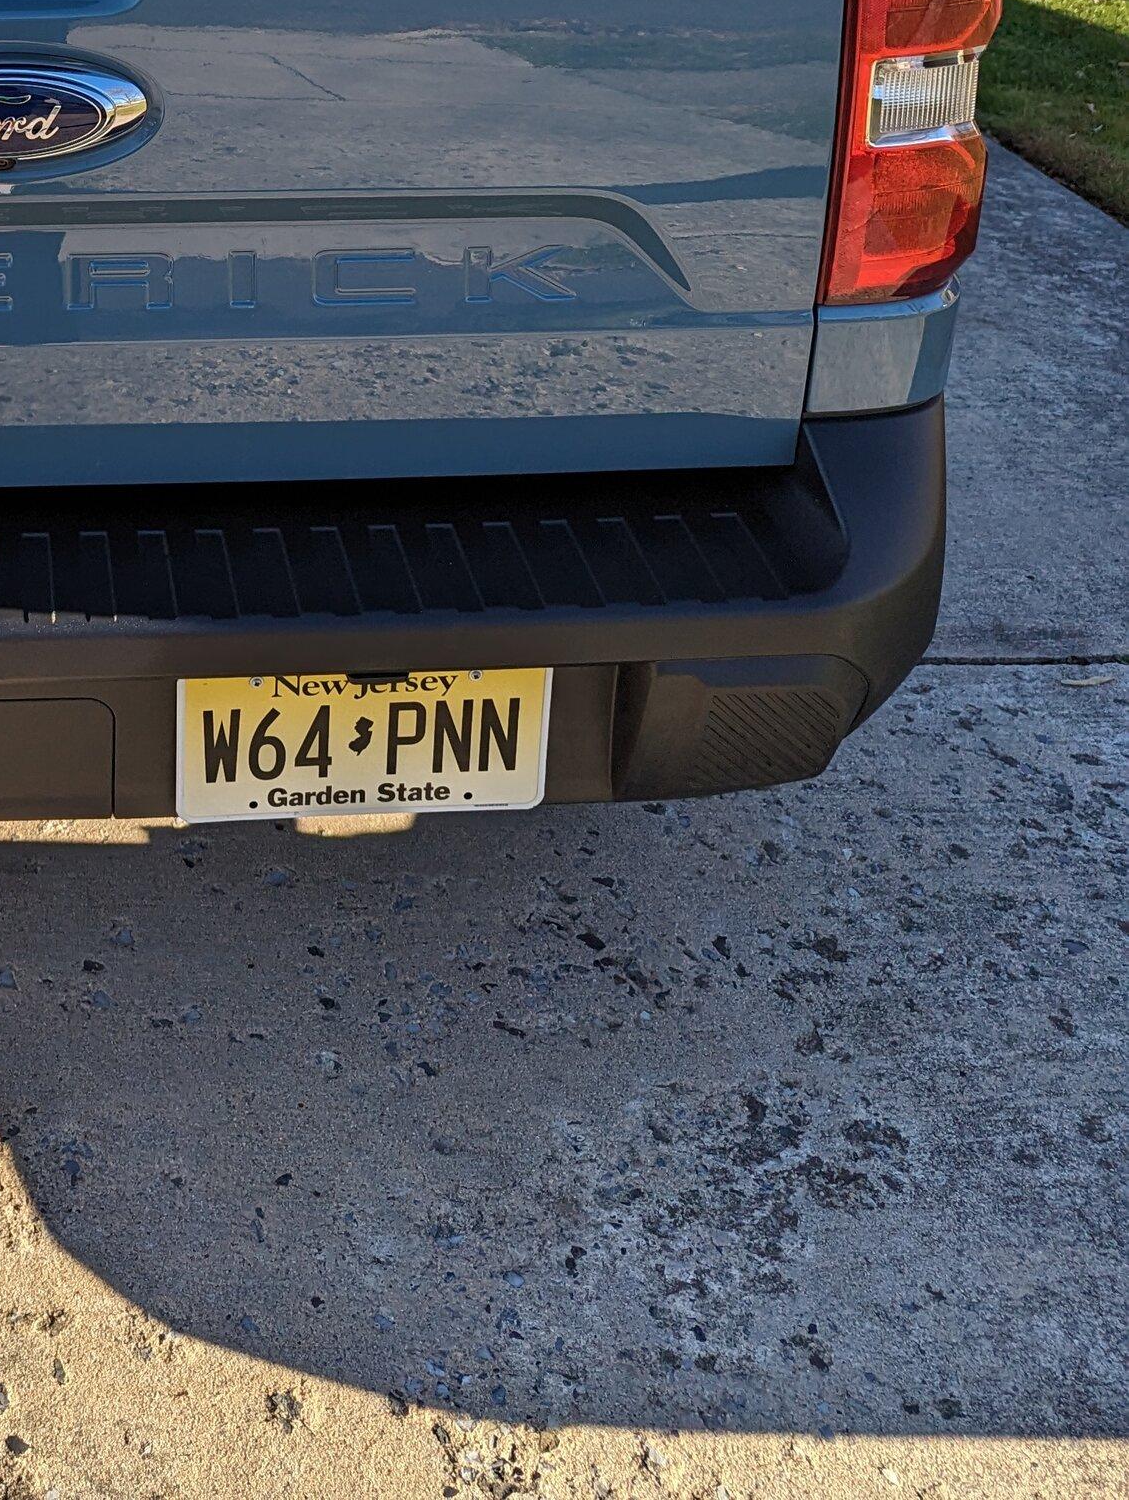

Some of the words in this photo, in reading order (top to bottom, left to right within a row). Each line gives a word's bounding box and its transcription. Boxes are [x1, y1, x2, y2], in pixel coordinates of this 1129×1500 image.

[271, 675, 350, 698] New
[202, 704, 332, 784] W64
[386, 697, 521, 775] PNN
[267, 785, 366, 808] Garden
[377, 782, 451, 803] State
